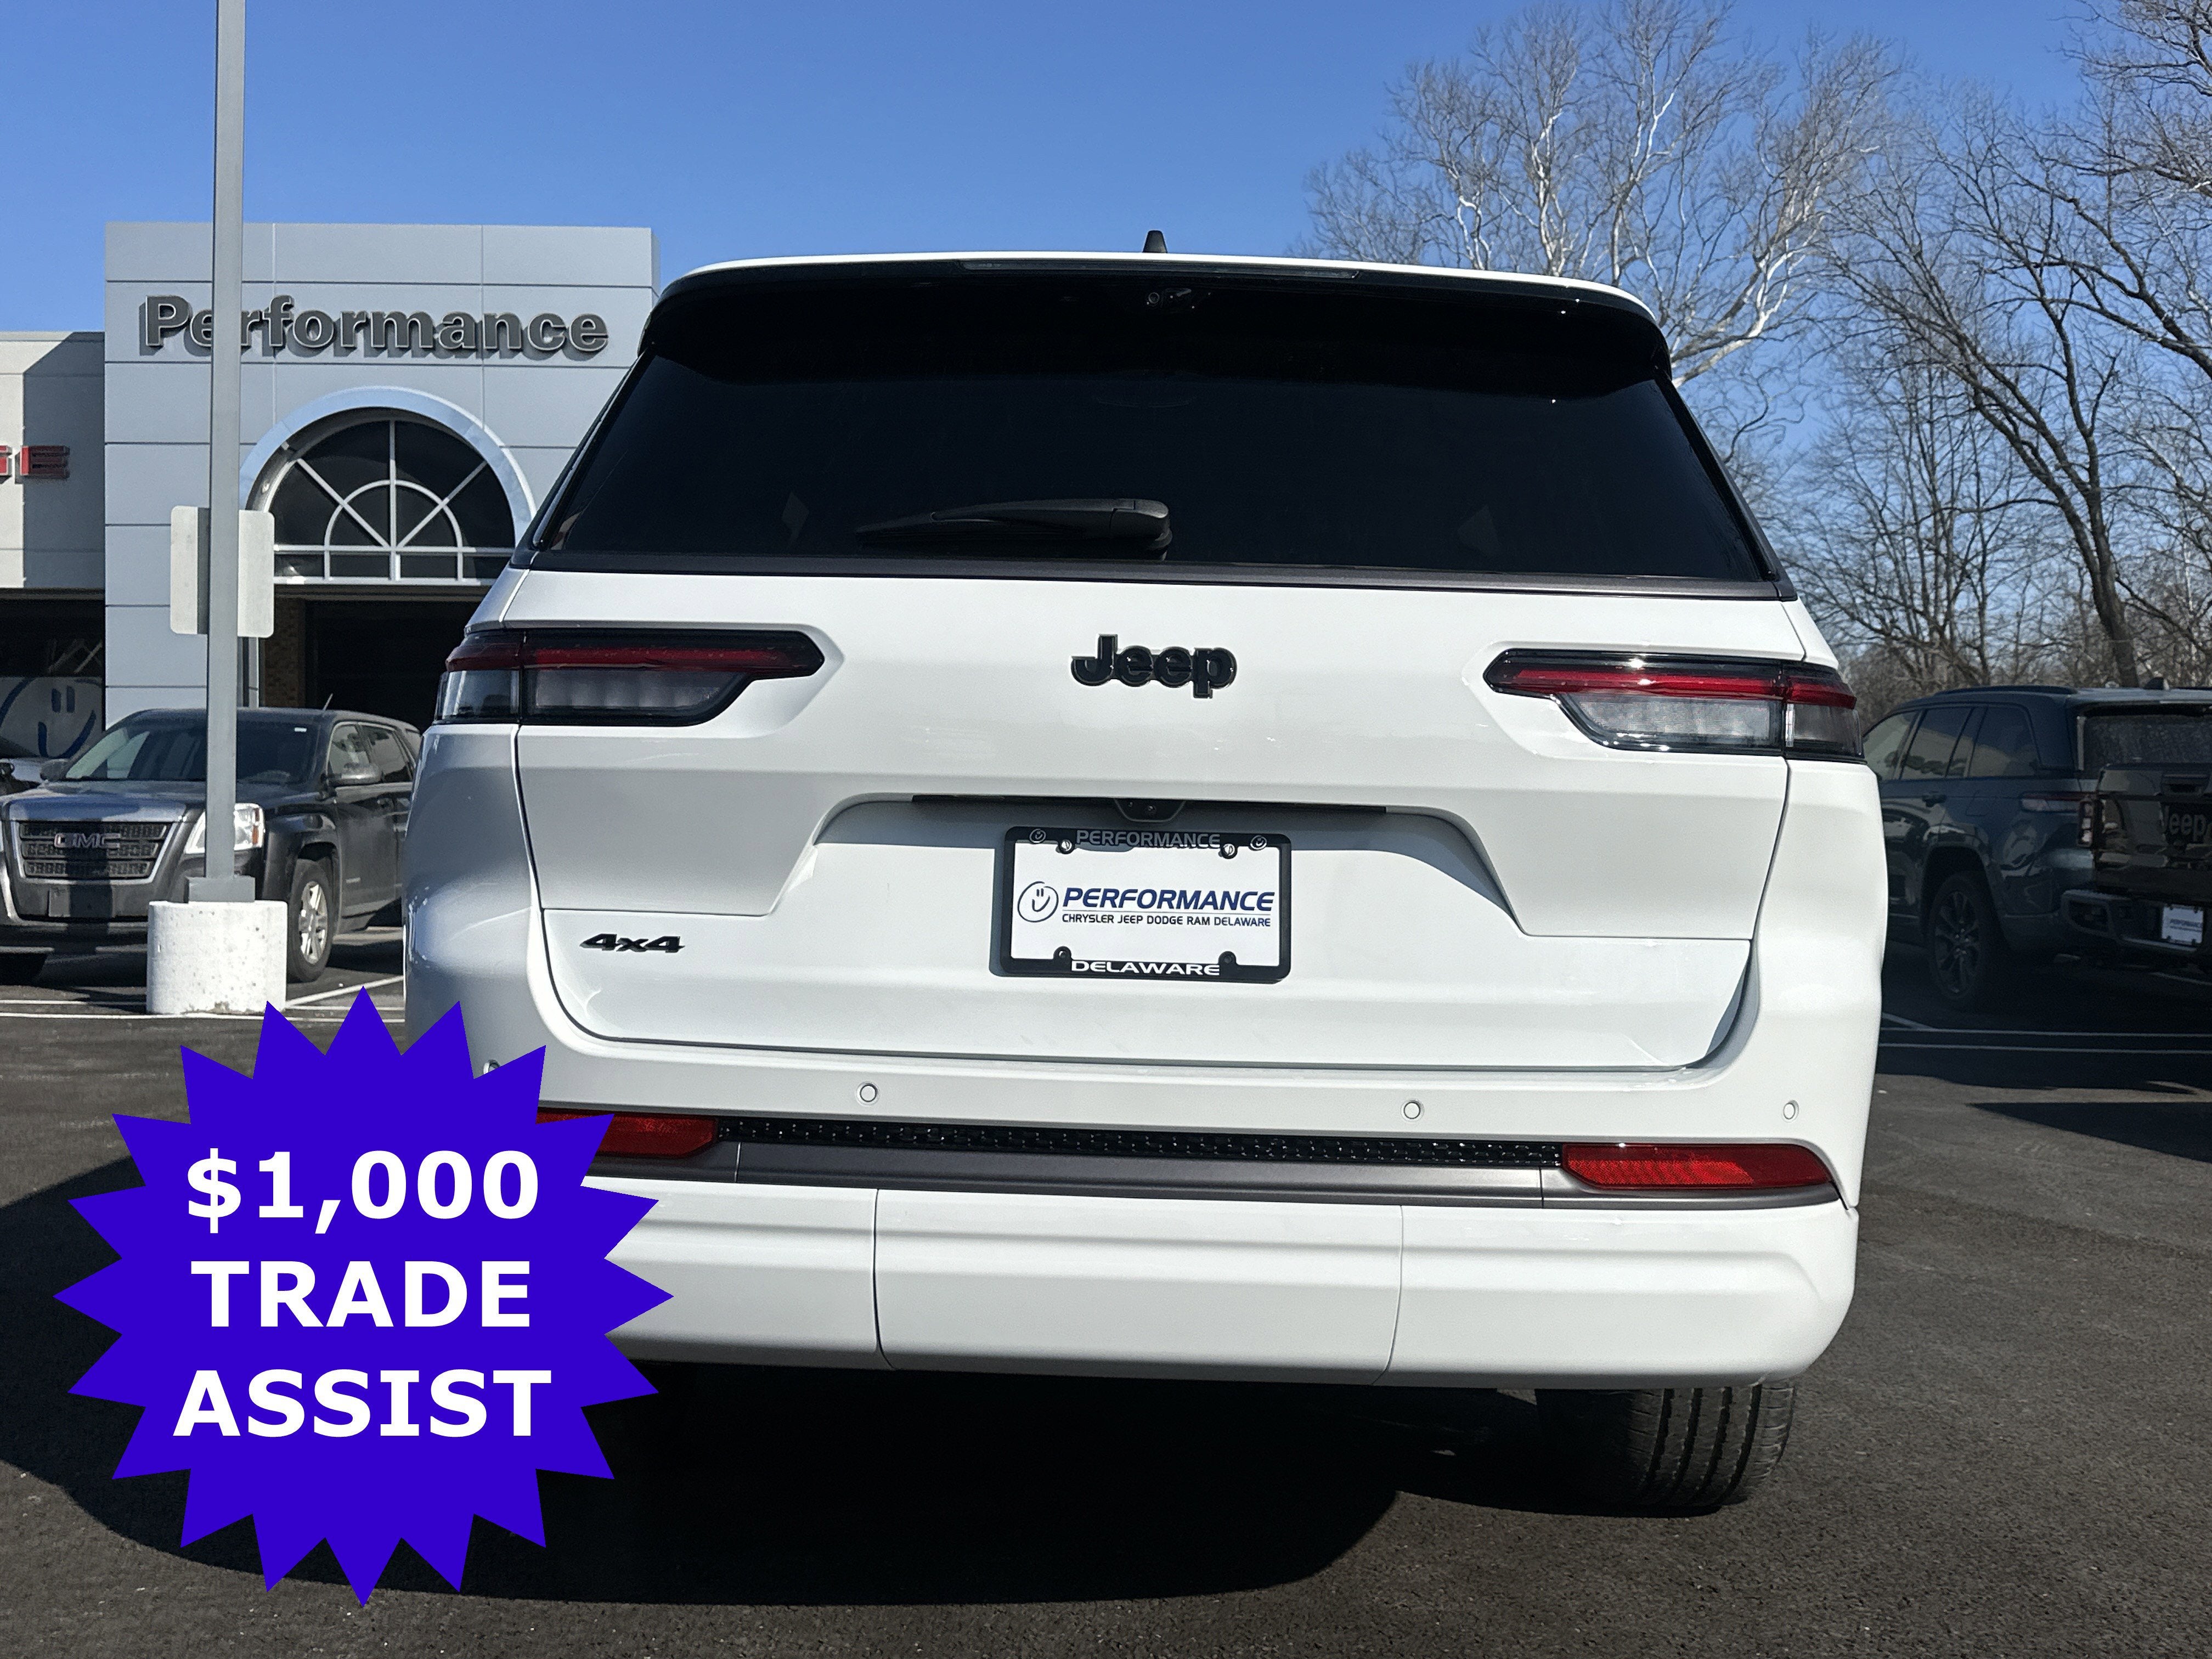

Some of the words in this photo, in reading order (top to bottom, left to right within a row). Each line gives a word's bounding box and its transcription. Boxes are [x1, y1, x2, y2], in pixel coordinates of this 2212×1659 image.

[145, 295, 608, 352] Performance
[0, 445, 70, 478] E
[1071, 634, 1237, 698] Jeep
[54, 833, 121, 848] GMC
[1076, 829, 1221, 849] PERFORMANCE
[1062, 887, 1276, 912] PERFORMANCE
[1062, 913, 1114, 924] CHRYSLER
[1117, 915, 1143, 924] JEEP
[1146, 915, 1183, 925] DODGE
[1186, 916, 1210, 926] RAM
[1214, 917, 1271, 927] DELAWARE
[579, 933, 685, 953] 4x4
[1071, 960, 1220, 976] DELAWARE
